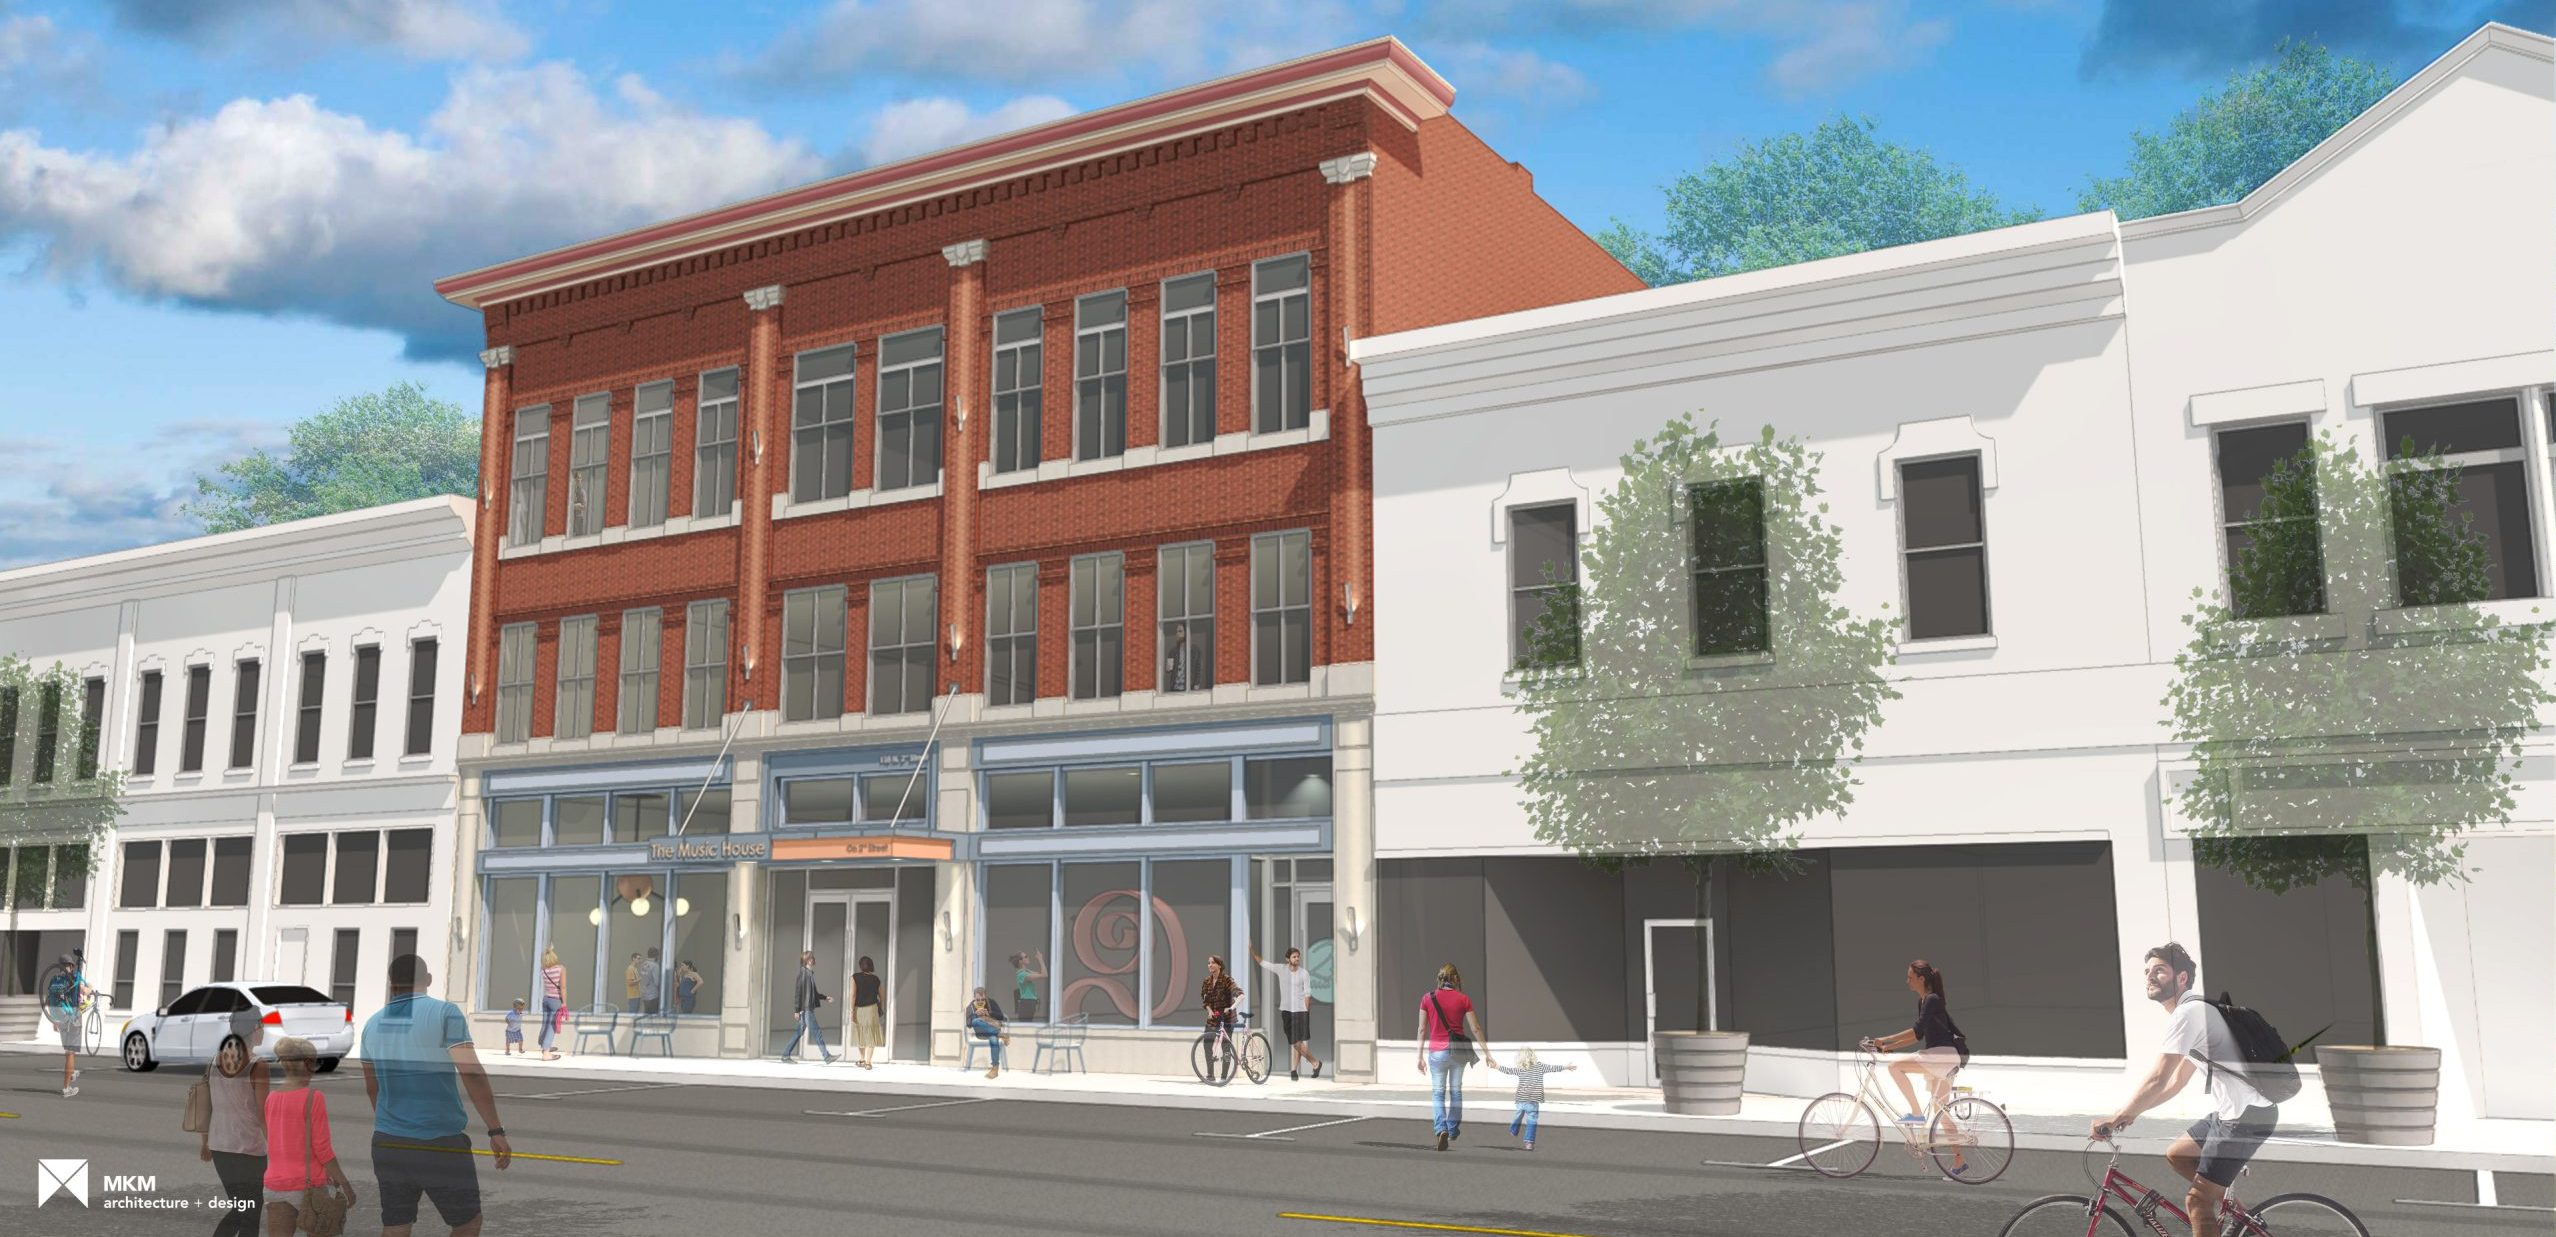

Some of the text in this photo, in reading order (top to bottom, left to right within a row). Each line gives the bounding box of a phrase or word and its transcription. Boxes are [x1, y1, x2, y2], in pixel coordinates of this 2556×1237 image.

[651, 840, 765, 859] The Music House
